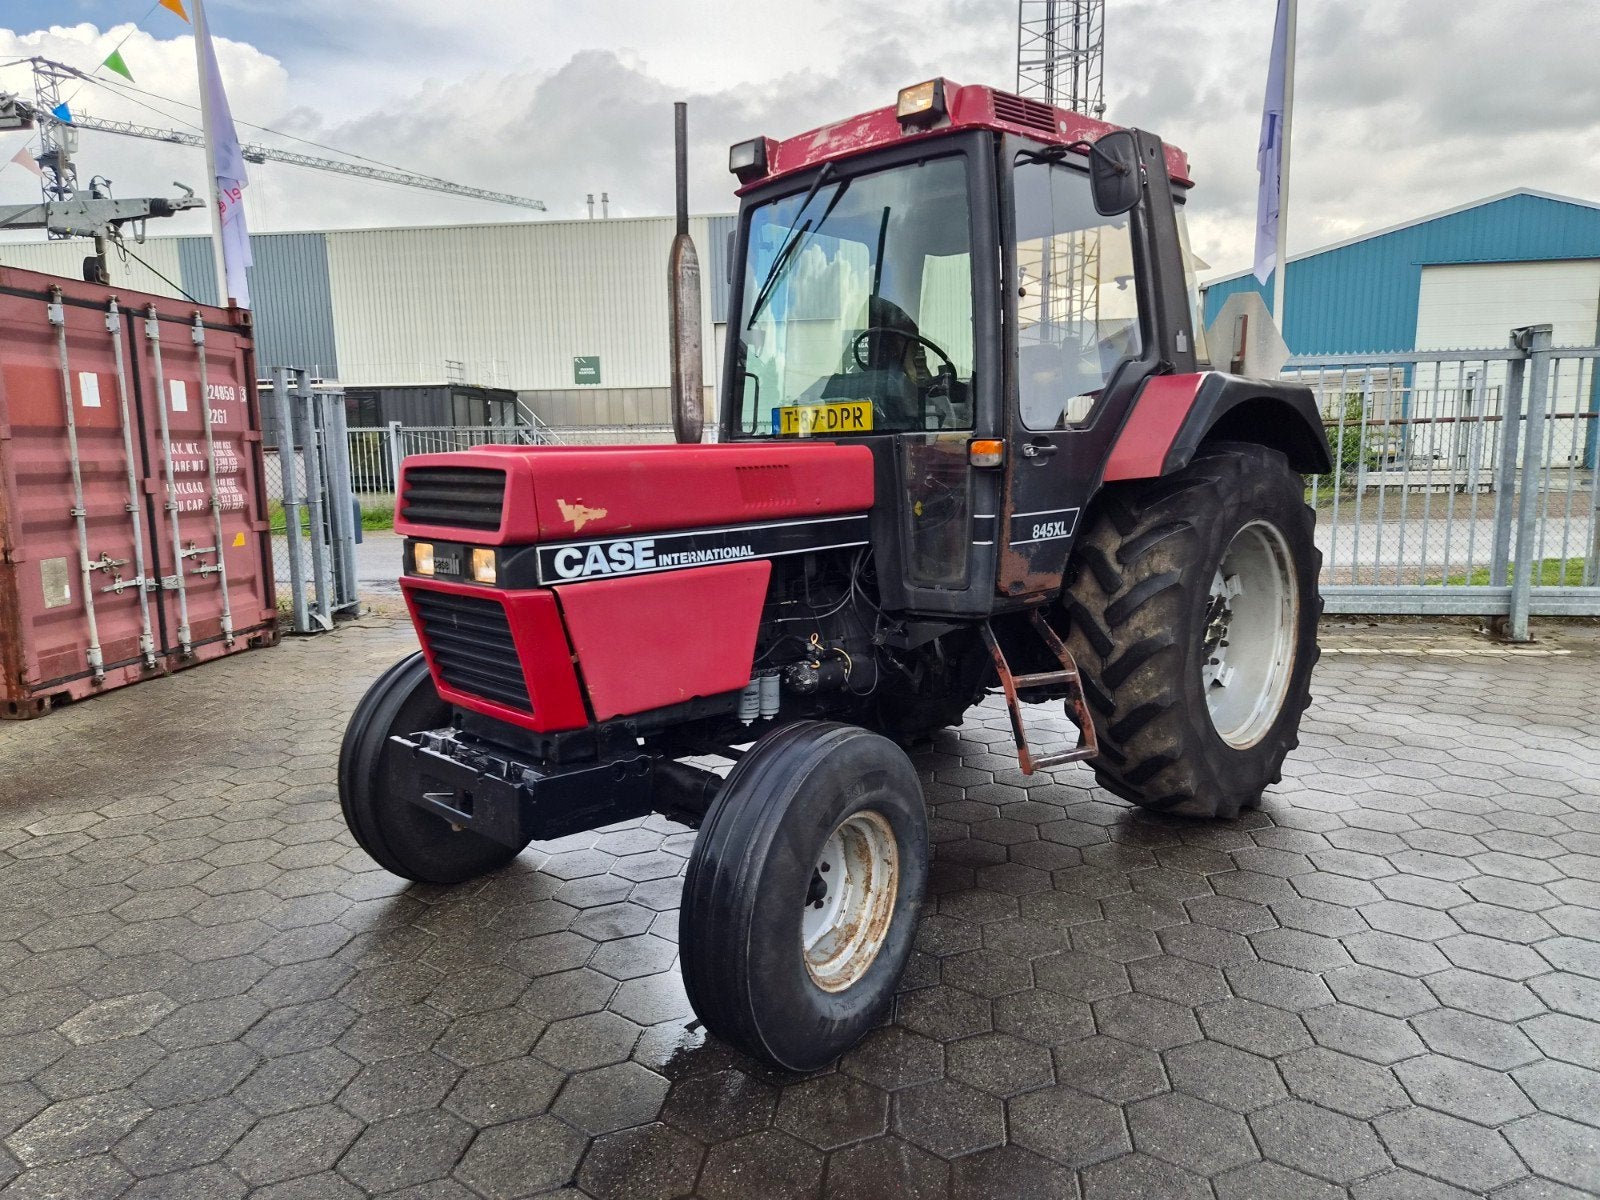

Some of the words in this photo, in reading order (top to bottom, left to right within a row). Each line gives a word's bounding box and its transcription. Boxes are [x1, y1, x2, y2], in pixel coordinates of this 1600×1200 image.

[785, 406, 864, 431] T-87-DPR
[1032, 521, 1067, 538] 845XL
[554, 540, 656, 578] CASE
[658, 545, 755, 566] INTERNATIONAL
